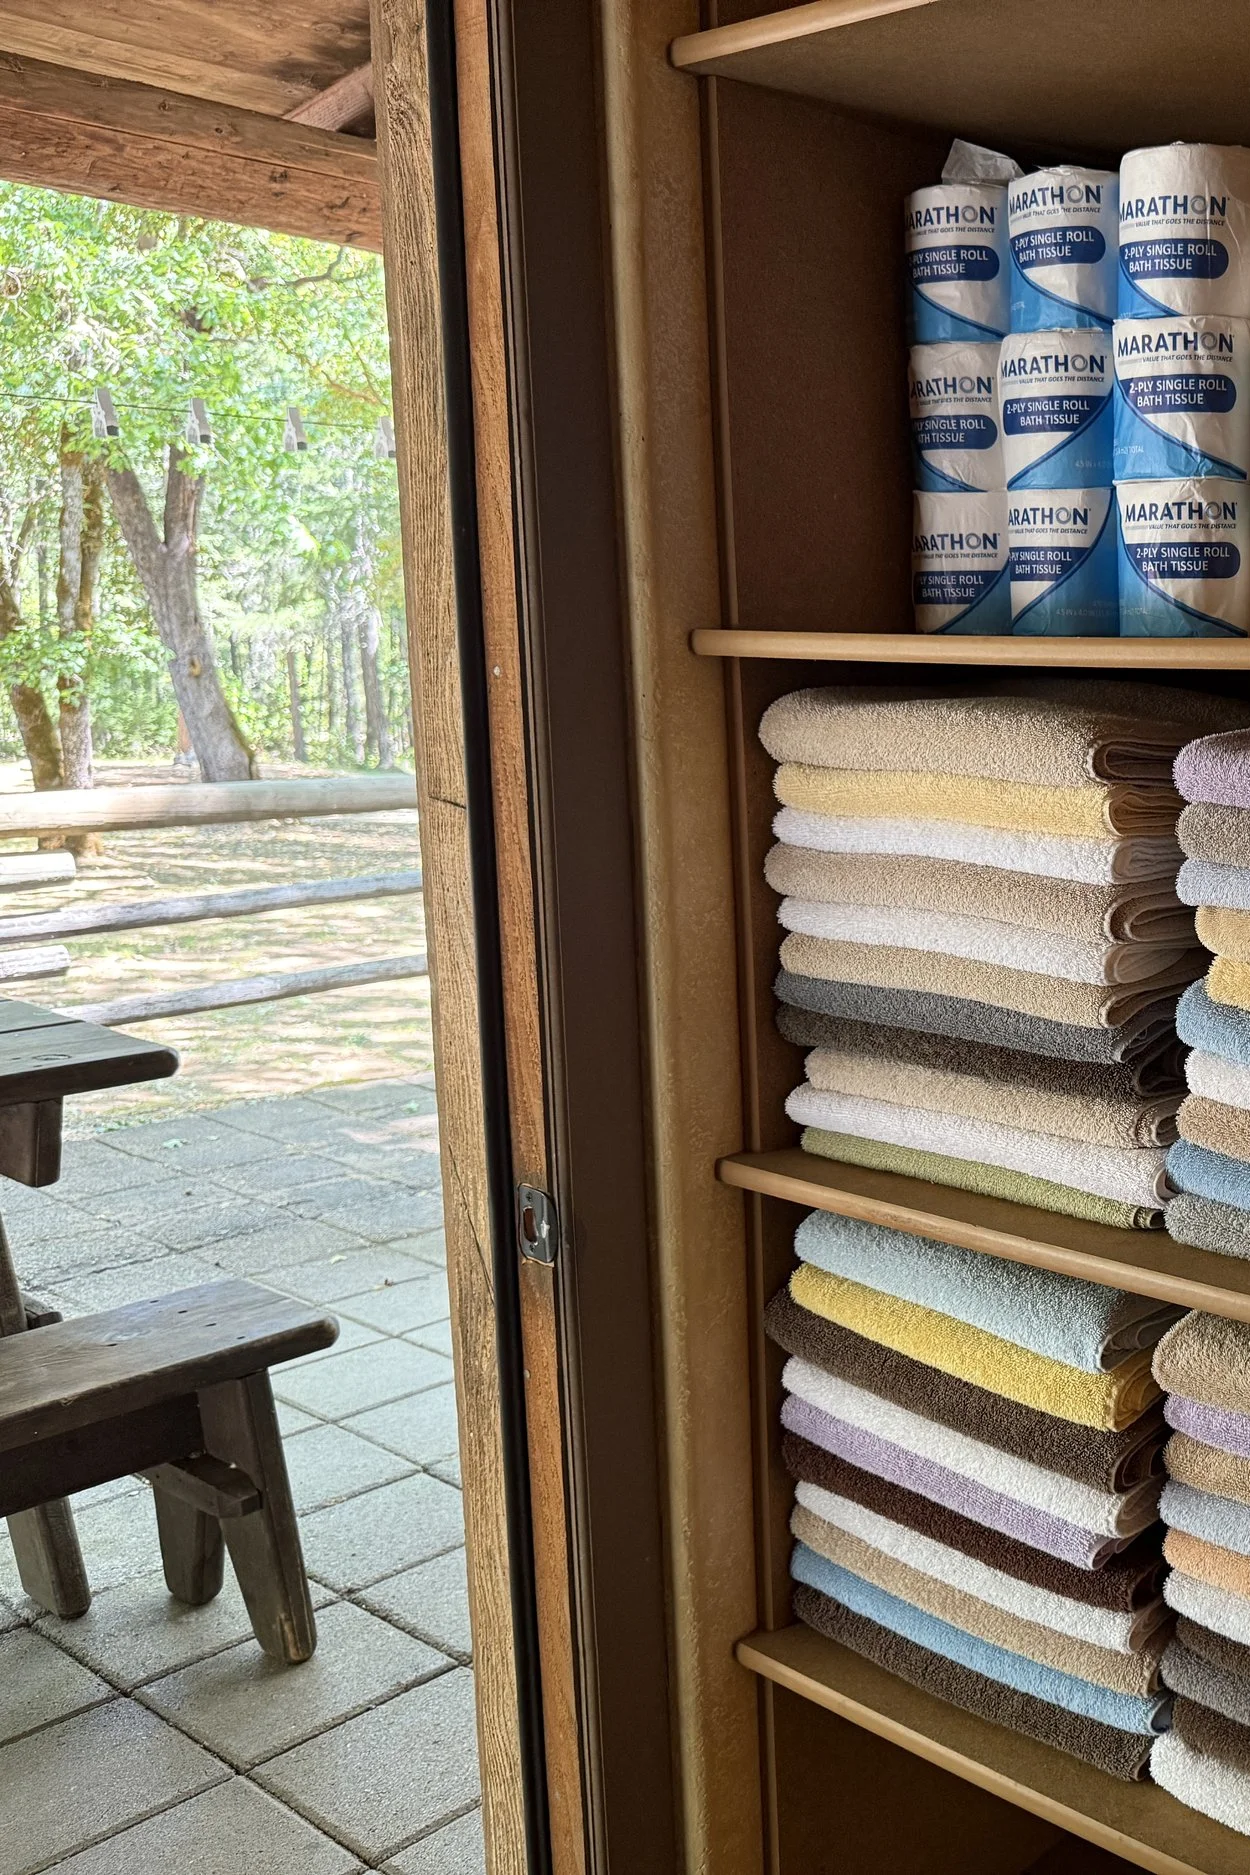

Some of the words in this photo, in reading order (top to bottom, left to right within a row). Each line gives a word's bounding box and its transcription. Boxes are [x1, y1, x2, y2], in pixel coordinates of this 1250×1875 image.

[1010, 185, 1101, 215] MARATHON
[1073, 206, 1101, 214] DISTANCE
[1015, 238, 1029, 251] 2-PLY
[1030, 232, 1063, 246] SINGLE
[1066, 231, 1094, 242] ROLL
[925, 250, 958, 262] SINGLE
[960, 250, 989, 260] ROLL
[1020, 250, 1036, 264] BATH
[1039, 246, 1072, 260] TISSUE
[1124, 246, 1145, 260] 2-PLY
[1146, 244, 1184, 256] SINGLE
[1188, 244, 1217, 256] ROLL
[912, 264, 931, 279] BATH
[933, 263, 966, 275] TISSUE
[1129, 260, 1152, 273] BATH
[1154, 258, 1192, 271] TISSUE
[1118, 332, 1233, 358] MARATHON
[1001, 354, 1104, 378] MARATHON
[908, 376, 992, 399] ARATHON
[1129, 381, 1154, 394] 2-PLY
[1156, 379, 1196, 392] SINGLE
[1198, 379, 1227, 391] ROLL
[1007, 402, 1026, 414] 2-PLY
[1028, 400, 1060, 412] SINGLE
[1062, 400, 1090, 411] ROLL
[1137, 395, 1162, 408] BATH
[1165, 394, 1204, 405] TISSUE
[924, 420, 958, 430] SINGLE
[960, 420, 986, 430] ROLL
[1020, 416, 1042, 426] BATH
[1044, 414, 1080, 425] TISSUE
[932, 432, 965, 442] TISSUE
[1008, 507, 1088, 526] ARATHON
[1125, 501, 1236, 522] MARATHON
[912, 532, 998, 552] ARATHON
[1020, 551, 1045, 561] SINGLE
[1047, 551, 1072, 561] ROLL
[1136, 548, 1158, 558] 2-PLY
[1160, 547, 1200, 558] SINGLE
[1204, 547, 1230, 558] ROLL
[1015, 564, 1030, 574] BATH
[1032, 564, 1062, 574] TISSUE
[1142, 561, 1168, 572] BATH
[1170, 560, 1208, 572] TISSUE
[928, 576, 957, 585] SINGLE
[959, 576, 984, 584] ROLL
[922, 588, 942, 598] BATH
[943, 588, 975, 598] TISSUE
